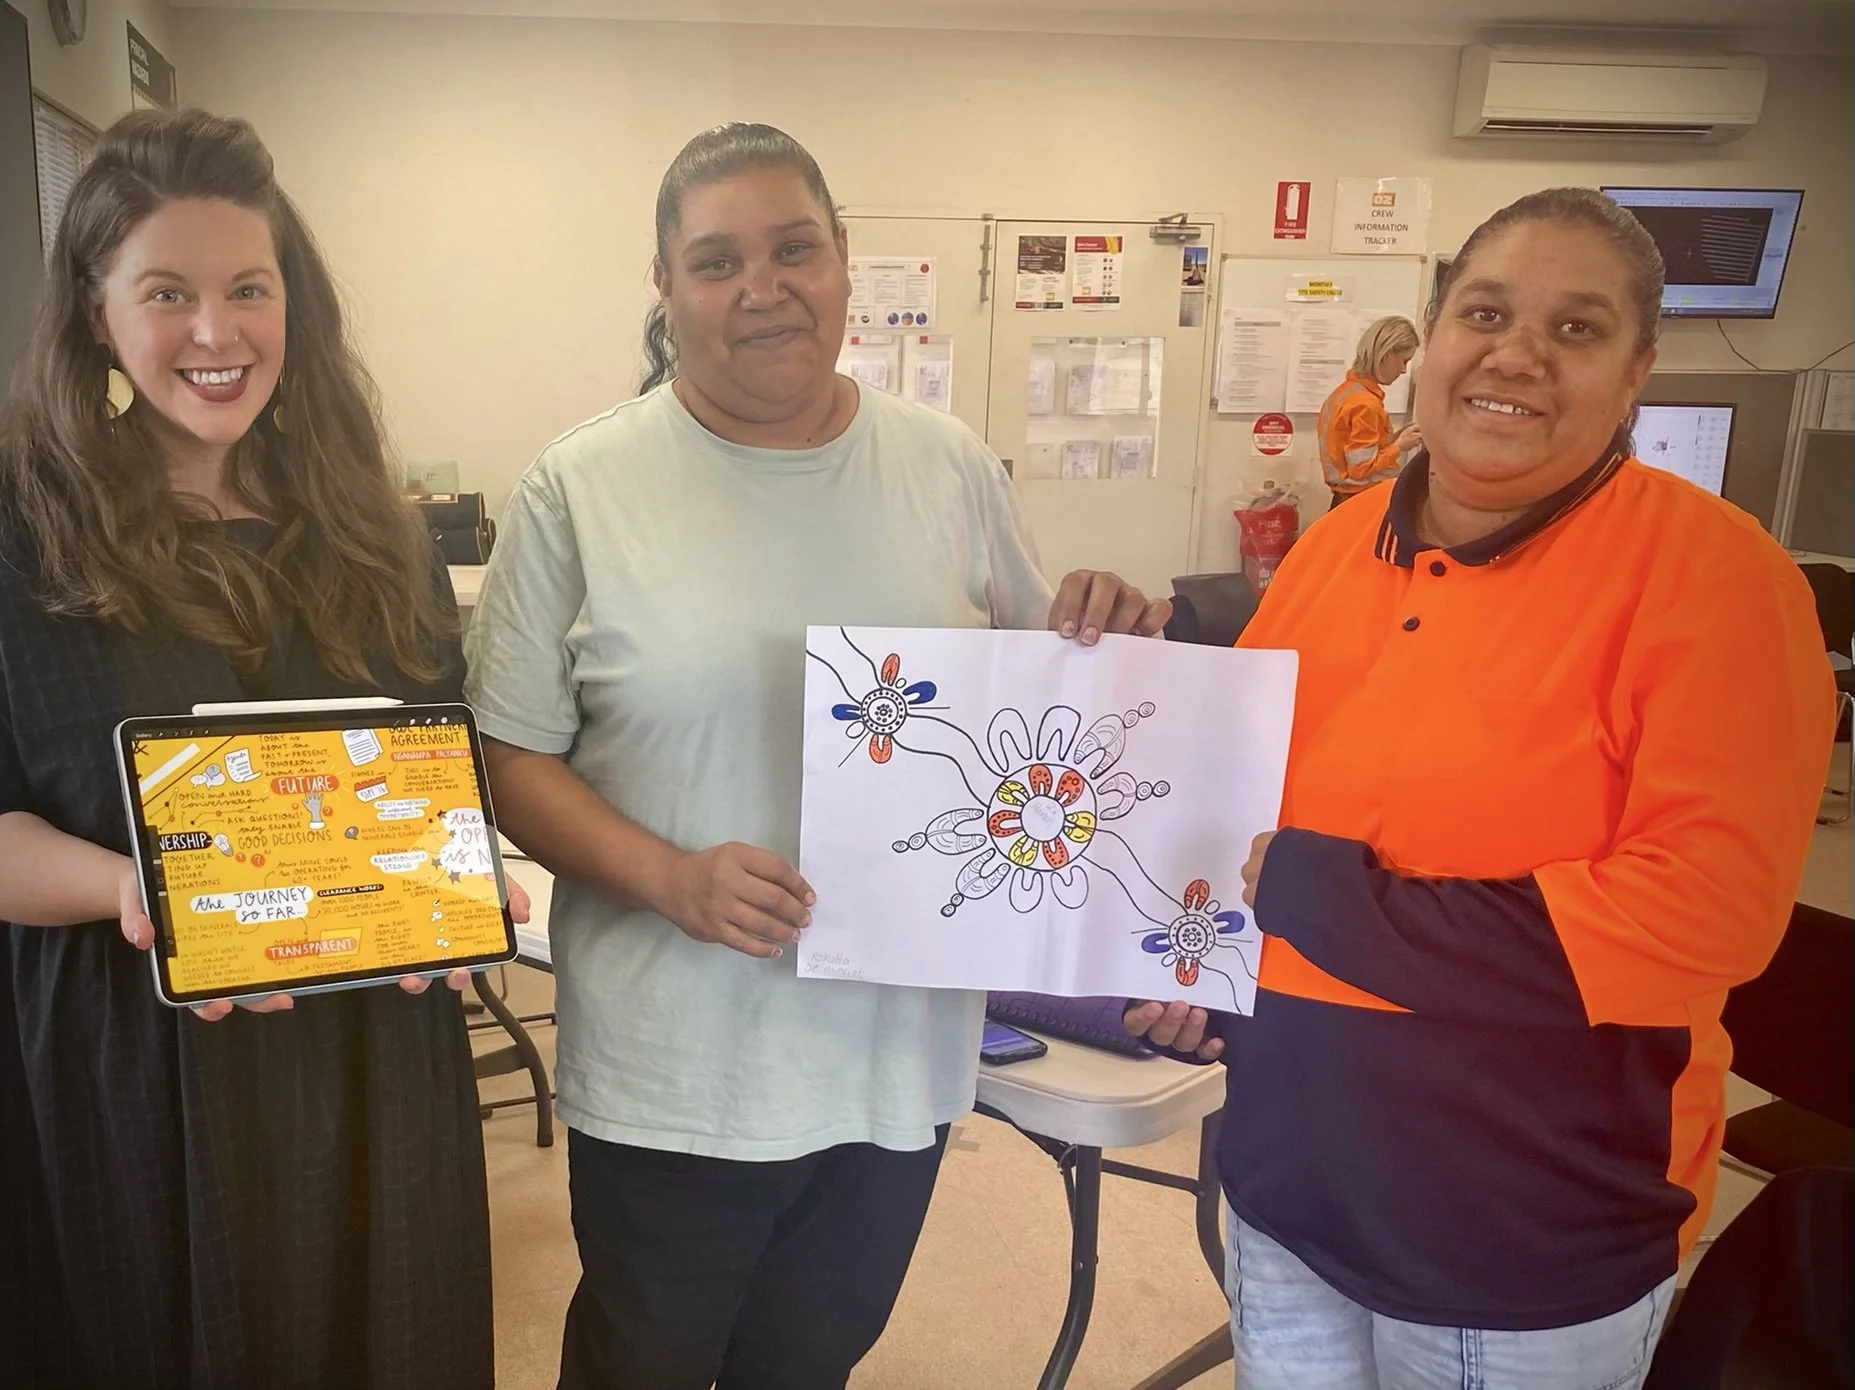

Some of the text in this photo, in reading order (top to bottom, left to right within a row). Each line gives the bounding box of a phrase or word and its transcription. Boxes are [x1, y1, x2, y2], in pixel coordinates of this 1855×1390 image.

[1371, 210, 1395, 218] CREW
[1354, 223, 1409, 232] INFORMATION
[1364, 237, 1398, 245] TRACKER
[391, 731, 461, 747] AGREEMENT
[265, 760, 313, 768] TOMORROW
[277, 776, 334, 794] FUTURE
[179, 791, 205, 801] OPEN
[229, 789, 252, 797] HARD
[449, 812, 481, 826] the
[268, 822, 301, 830] ENABLE
[238, 829, 333, 850] GOOD DECISIONS
[195, 887, 307, 912] the JOURNEY
[269, 938, 353, 959] TRANSPARENT
